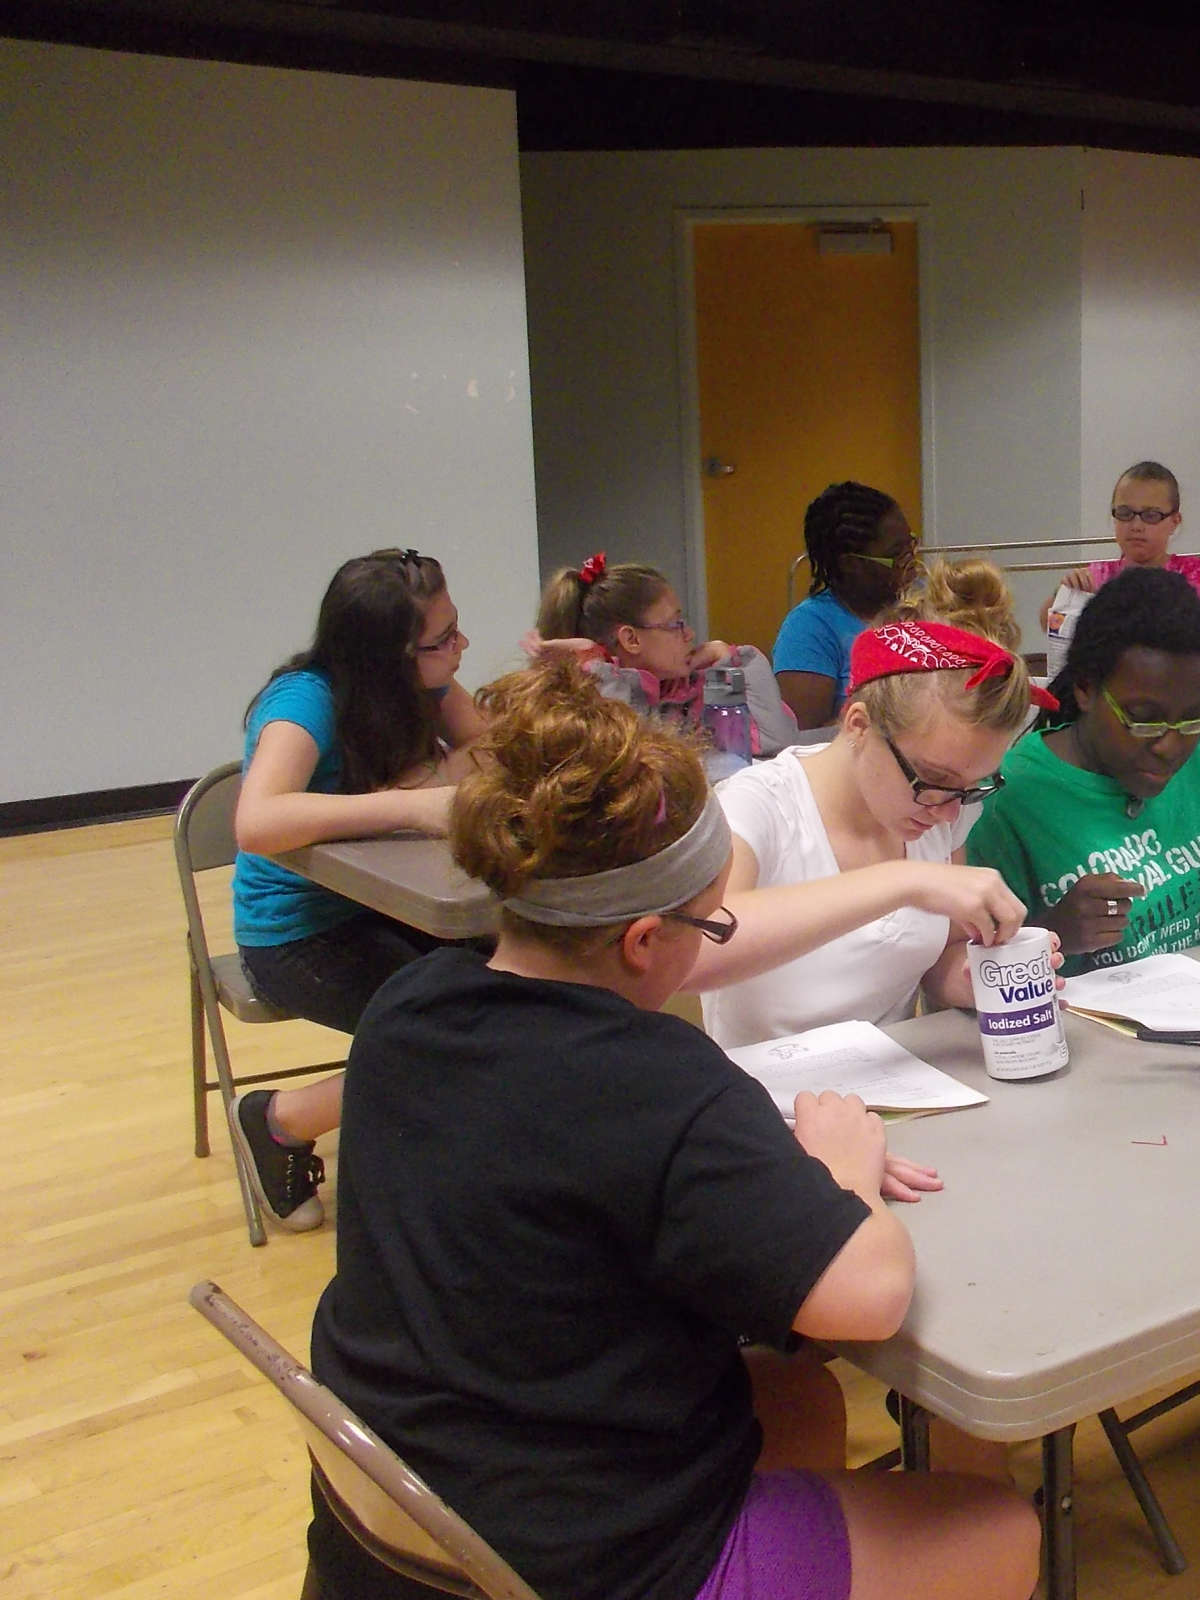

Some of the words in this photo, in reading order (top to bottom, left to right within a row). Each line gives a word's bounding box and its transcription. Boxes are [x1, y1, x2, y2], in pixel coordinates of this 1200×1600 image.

[979, 950, 1051, 988] Great
[1091, 952, 1124, 966] YOU
[999, 978, 1054, 1004] Value
[988, 1014, 1031, 1030] Iodized
[1033, 1009, 1053, 1025] Salt
